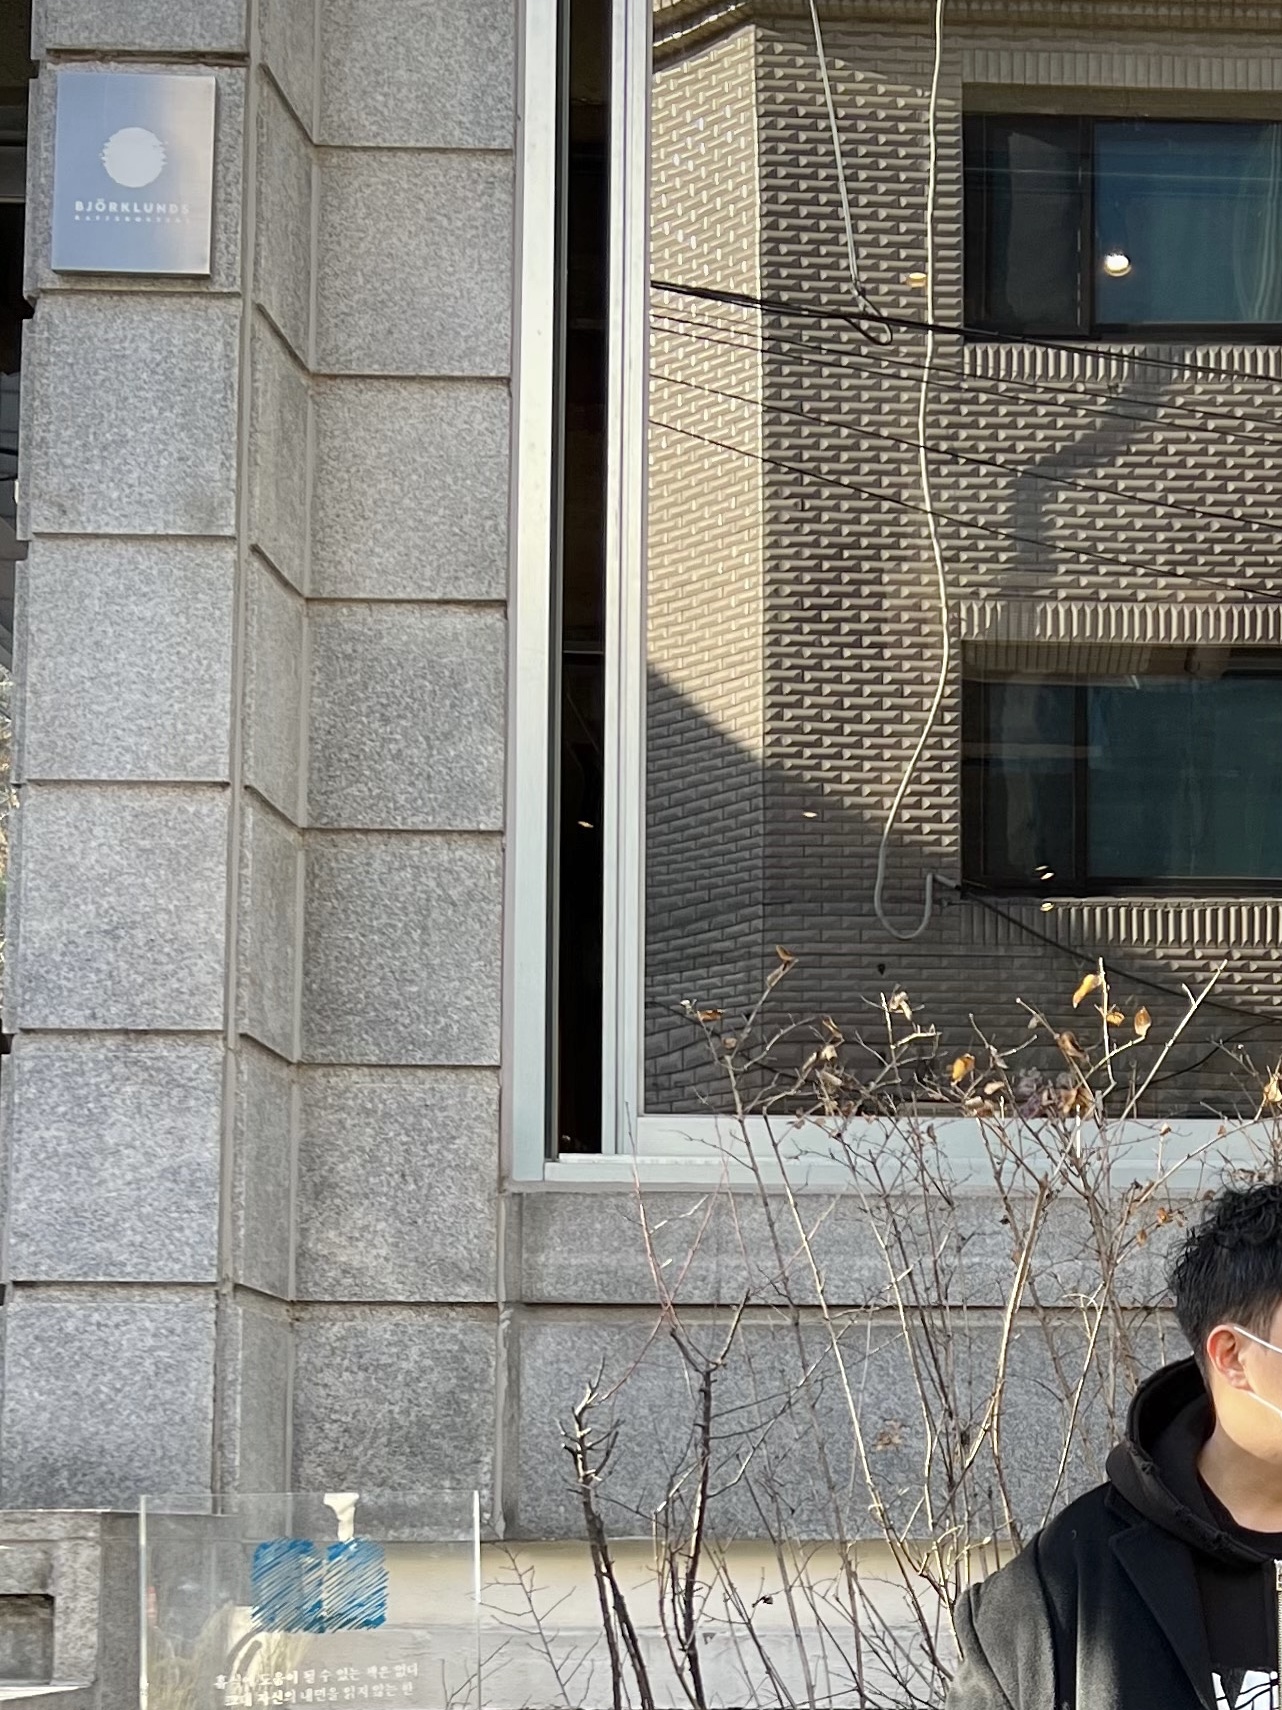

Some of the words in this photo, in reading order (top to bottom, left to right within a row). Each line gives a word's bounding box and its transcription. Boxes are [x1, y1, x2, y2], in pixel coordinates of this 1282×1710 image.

[75, 198, 189, 214] BJÖRKLUNDS
[258, 1670, 299, 1687] 도움이
[320, 1668, 332, 1683] 수
[336, 1667, 360, 1681] 있는
